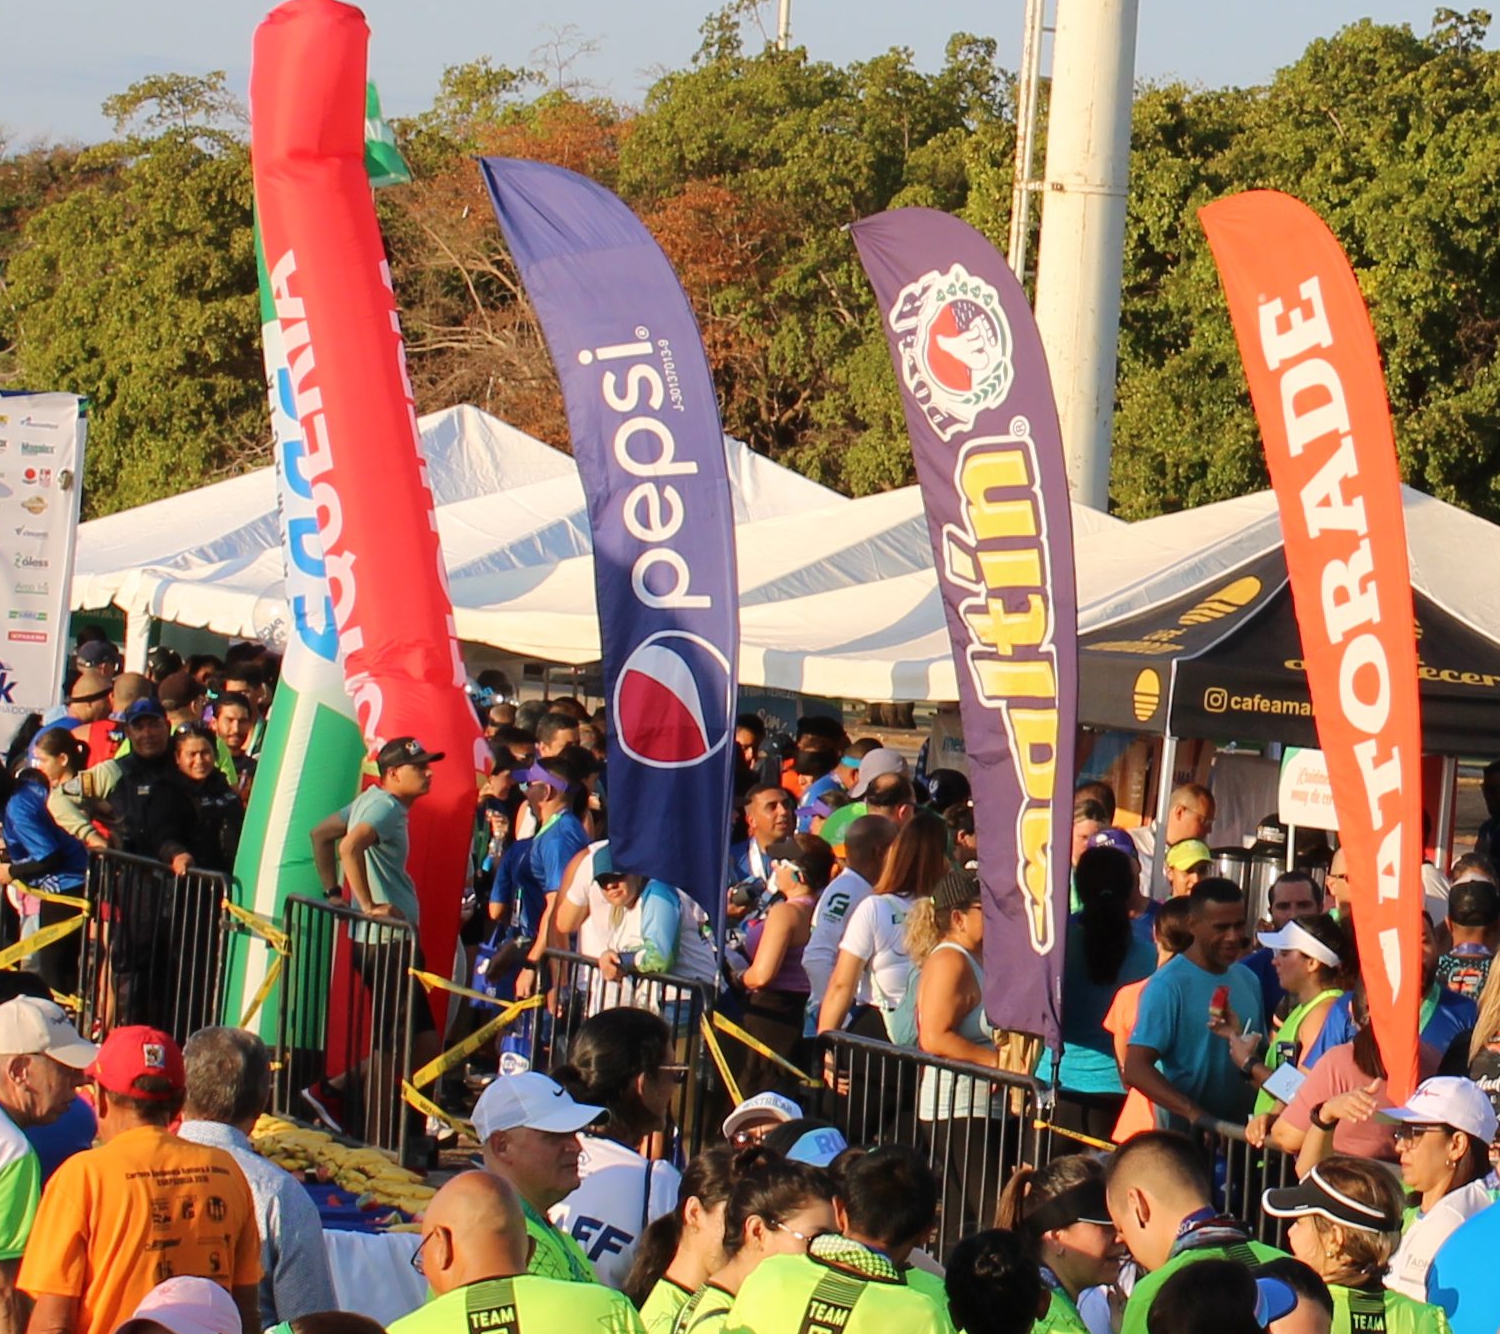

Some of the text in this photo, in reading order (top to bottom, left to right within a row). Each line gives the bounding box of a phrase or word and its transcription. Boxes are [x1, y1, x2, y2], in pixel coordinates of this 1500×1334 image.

[657, 338, 685, 413] J-30137013-9
[578, 339, 701, 611] pepsi
[469, 1307, 516, 1330] TEAM
[807, 1300, 851, 1327] TEAM
[1352, 1313, 1384, 1332] TEAM
